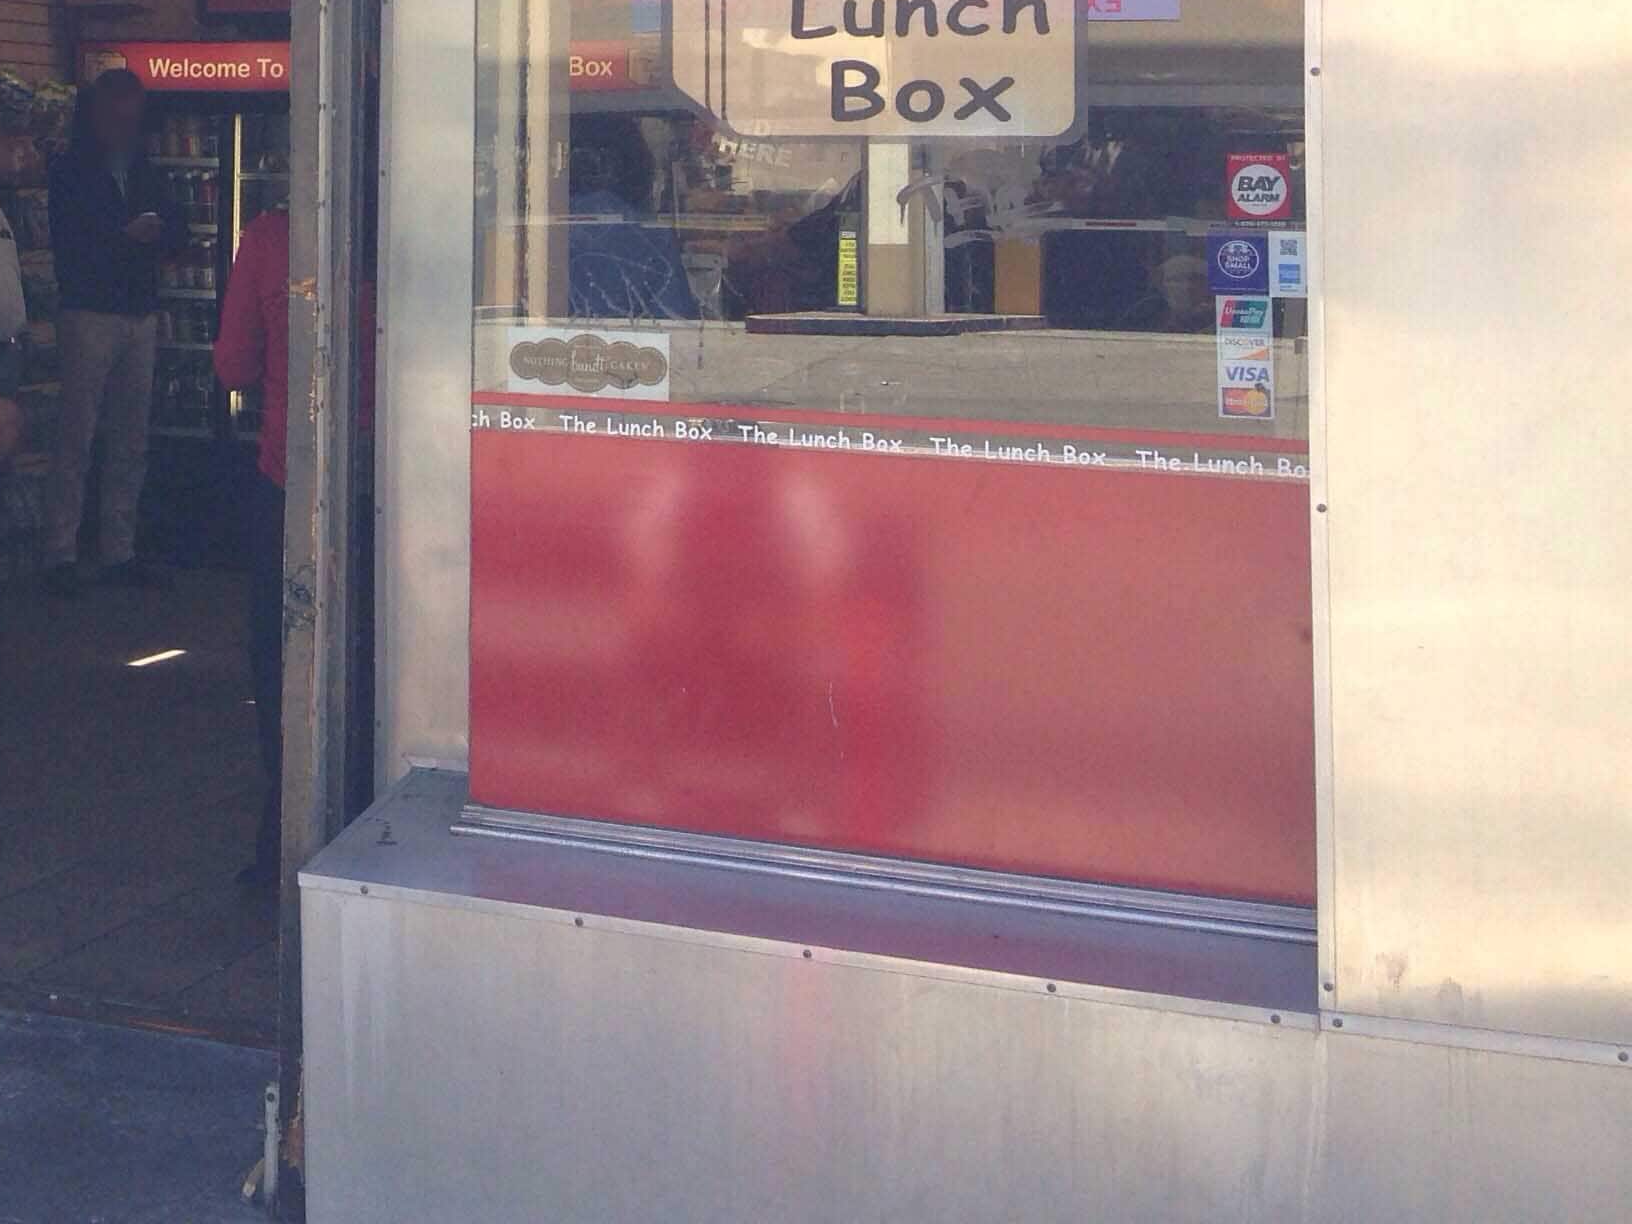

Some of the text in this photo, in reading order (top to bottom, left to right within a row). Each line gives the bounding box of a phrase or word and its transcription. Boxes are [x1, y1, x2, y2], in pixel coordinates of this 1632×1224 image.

[149, 57, 284, 79] Welcome To
[569, 55, 613, 77] Box
[830, 59, 1016, 124] Box
[1238, 176, 1280, 192] BAY
[1237, 193, 1280, 203] ALARM
[1226, 255, 1250, 263] SHOP
[571, 350, 605, 373] bundt
[1225, 366, 1270, 382] VISA
[500, 411, 536, 430] Box
[559, 414, 597, 434] The
[607, 417, 665, 439] Lunch
[675, 421, 713, 442] Box
[738, 425, 779, 445] The
[790, 428, 851, 450] Lunch
[863, 432, 903, 453] Box
[929, 436, 973, 458] The
[984, 439, 1051, 463] Lunch
[1062, 445, 1107, 467] Box
[1136, 449, 1183, 473] The
[1193, 452, 1264, 476] Lunch
[1276, 458, 1310, 479] Bo
